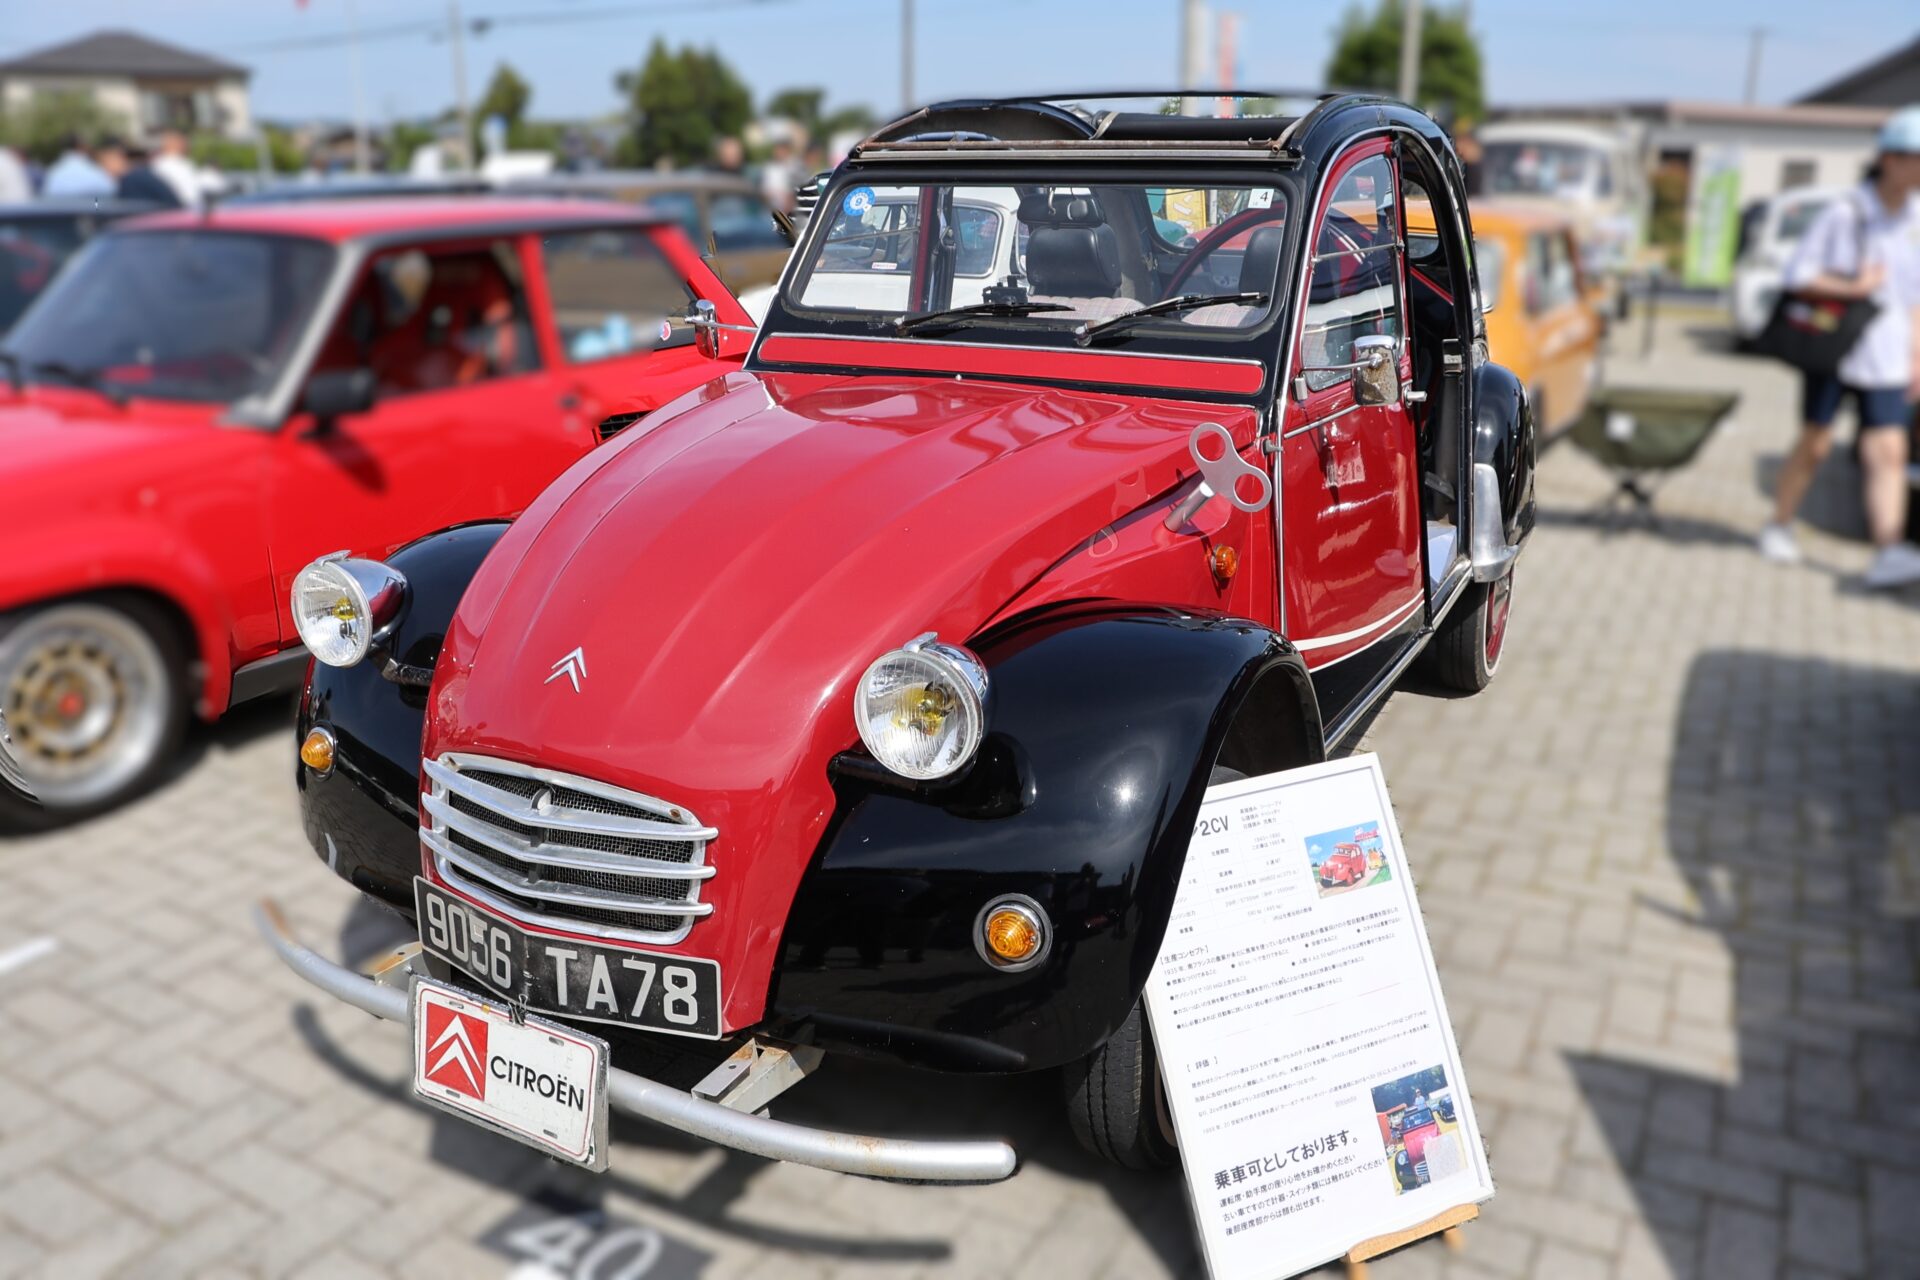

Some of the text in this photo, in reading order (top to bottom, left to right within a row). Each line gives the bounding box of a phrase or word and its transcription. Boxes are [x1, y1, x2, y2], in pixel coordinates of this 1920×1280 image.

[1260, 191, 1269, 202] 4
[427, 892, 512, 990] 9056
[490, 1055, 584, 1112] CITROËN
[1214, 1130, 1358, 1190] 乗車可としております。
